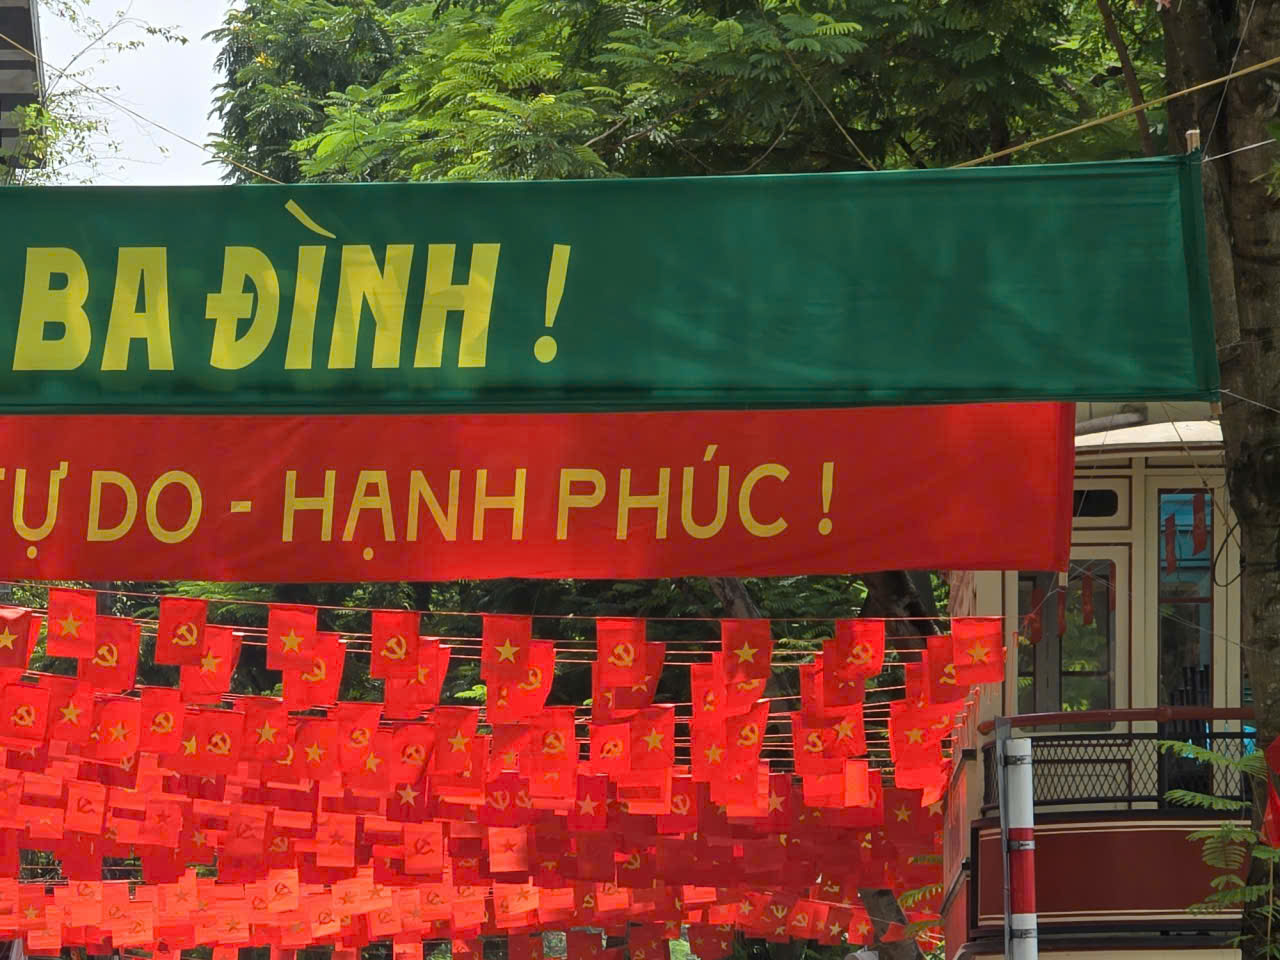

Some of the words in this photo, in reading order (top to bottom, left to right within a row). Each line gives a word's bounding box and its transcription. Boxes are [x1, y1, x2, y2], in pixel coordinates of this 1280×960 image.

[12, 246, 174, 371] BA
[205, 199, 501, 371] ĐÌNH
[533, 243, 571, 364] !
[87, 470, 203, 544] DO
[282, 468, 527, 560] HẠNH
[557, 444, 791, 540] PHÚC
[818, 461, 836, 535] !
